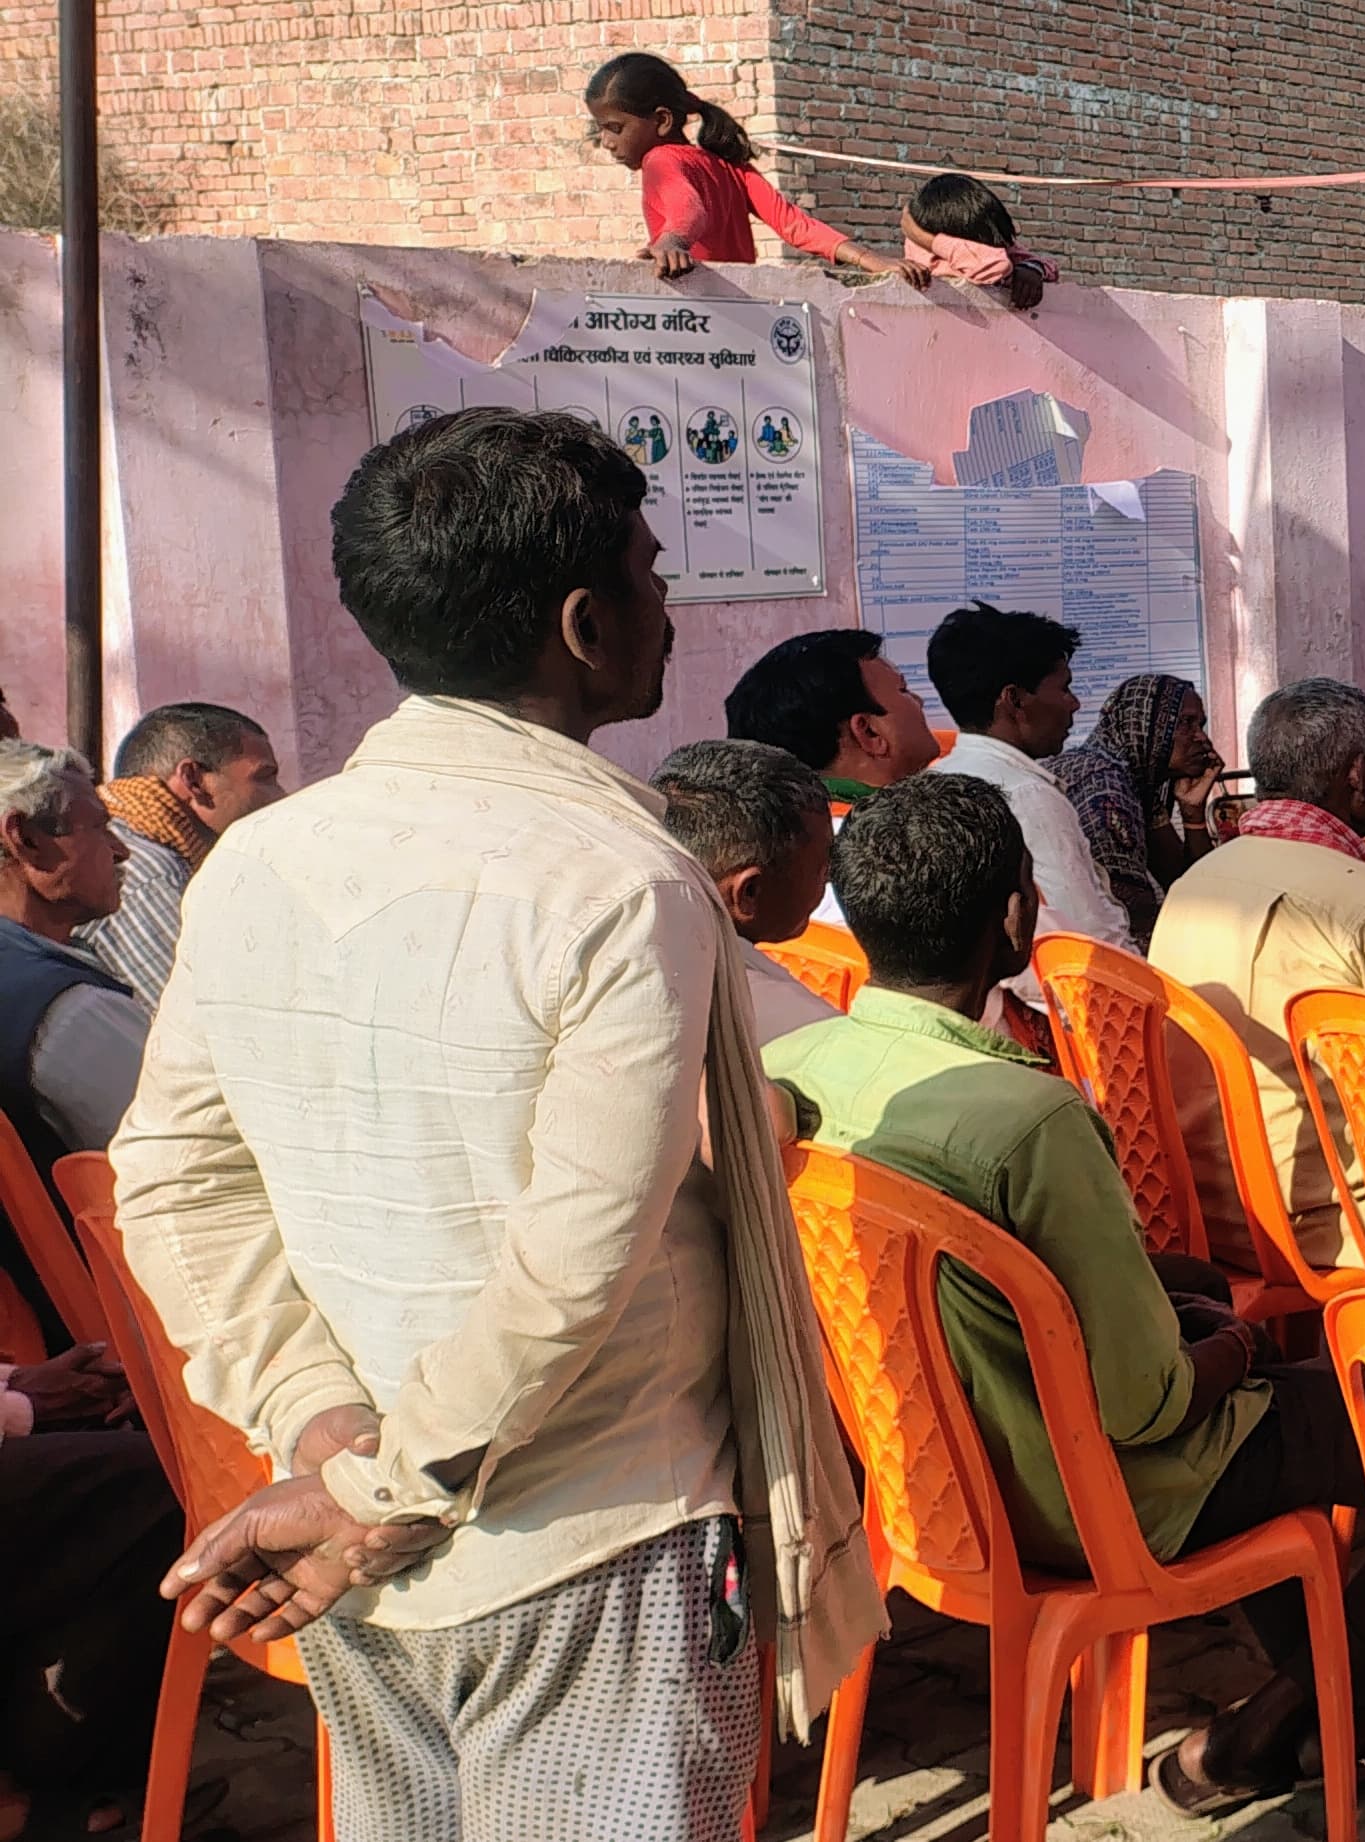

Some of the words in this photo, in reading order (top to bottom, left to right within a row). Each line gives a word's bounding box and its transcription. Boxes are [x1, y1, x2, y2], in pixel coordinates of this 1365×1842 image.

[585, 307, 657, 331] आरोग्य
[662, 308, 711, 333] मंदिर
[634, 347, 650, 364] एवं
